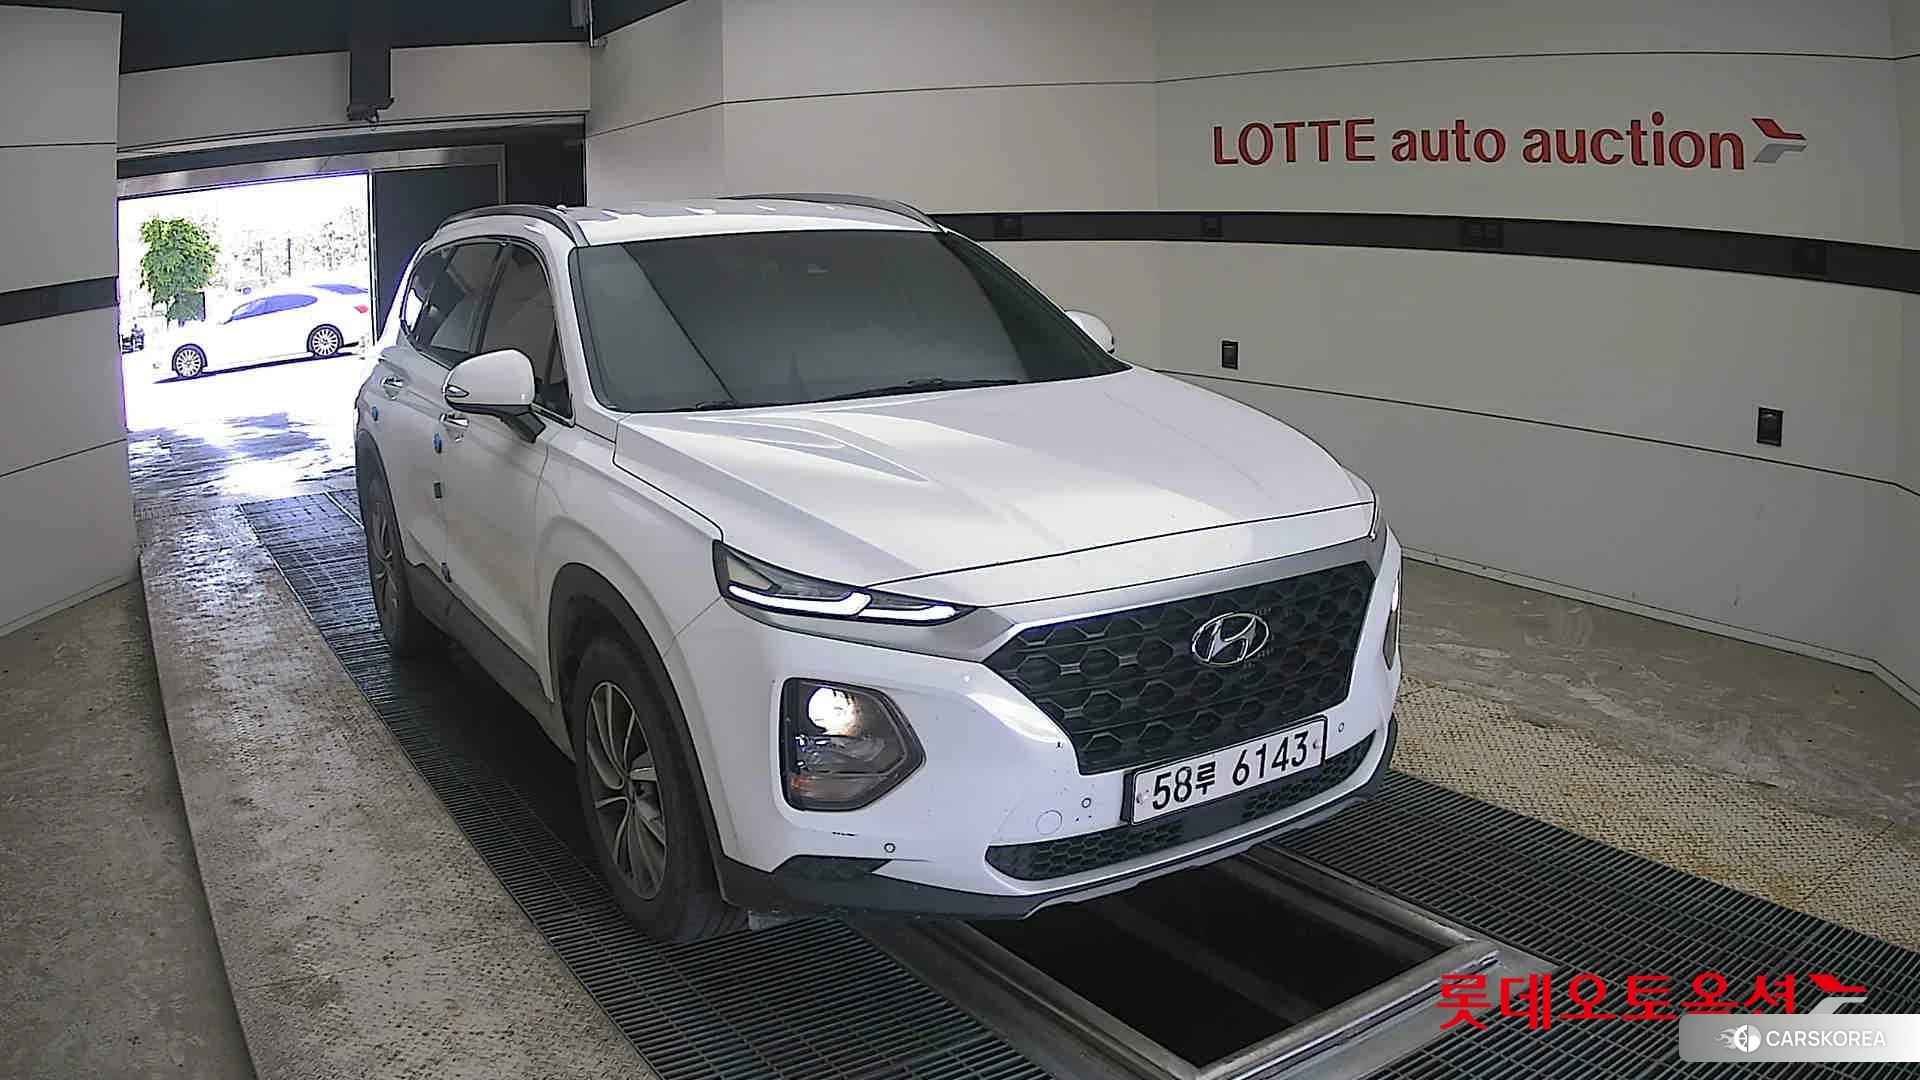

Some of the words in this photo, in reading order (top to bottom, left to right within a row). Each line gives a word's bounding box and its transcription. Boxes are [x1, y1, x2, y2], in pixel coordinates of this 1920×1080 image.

[1212, 117, 1376, 167] LOTTE
[1391, 118, 1507, 164] auto
[1522, 111, 1746, 171] auction
[1152, 760, 1216, 810] 58루
[1232, 730, 1309, 786] 6143
